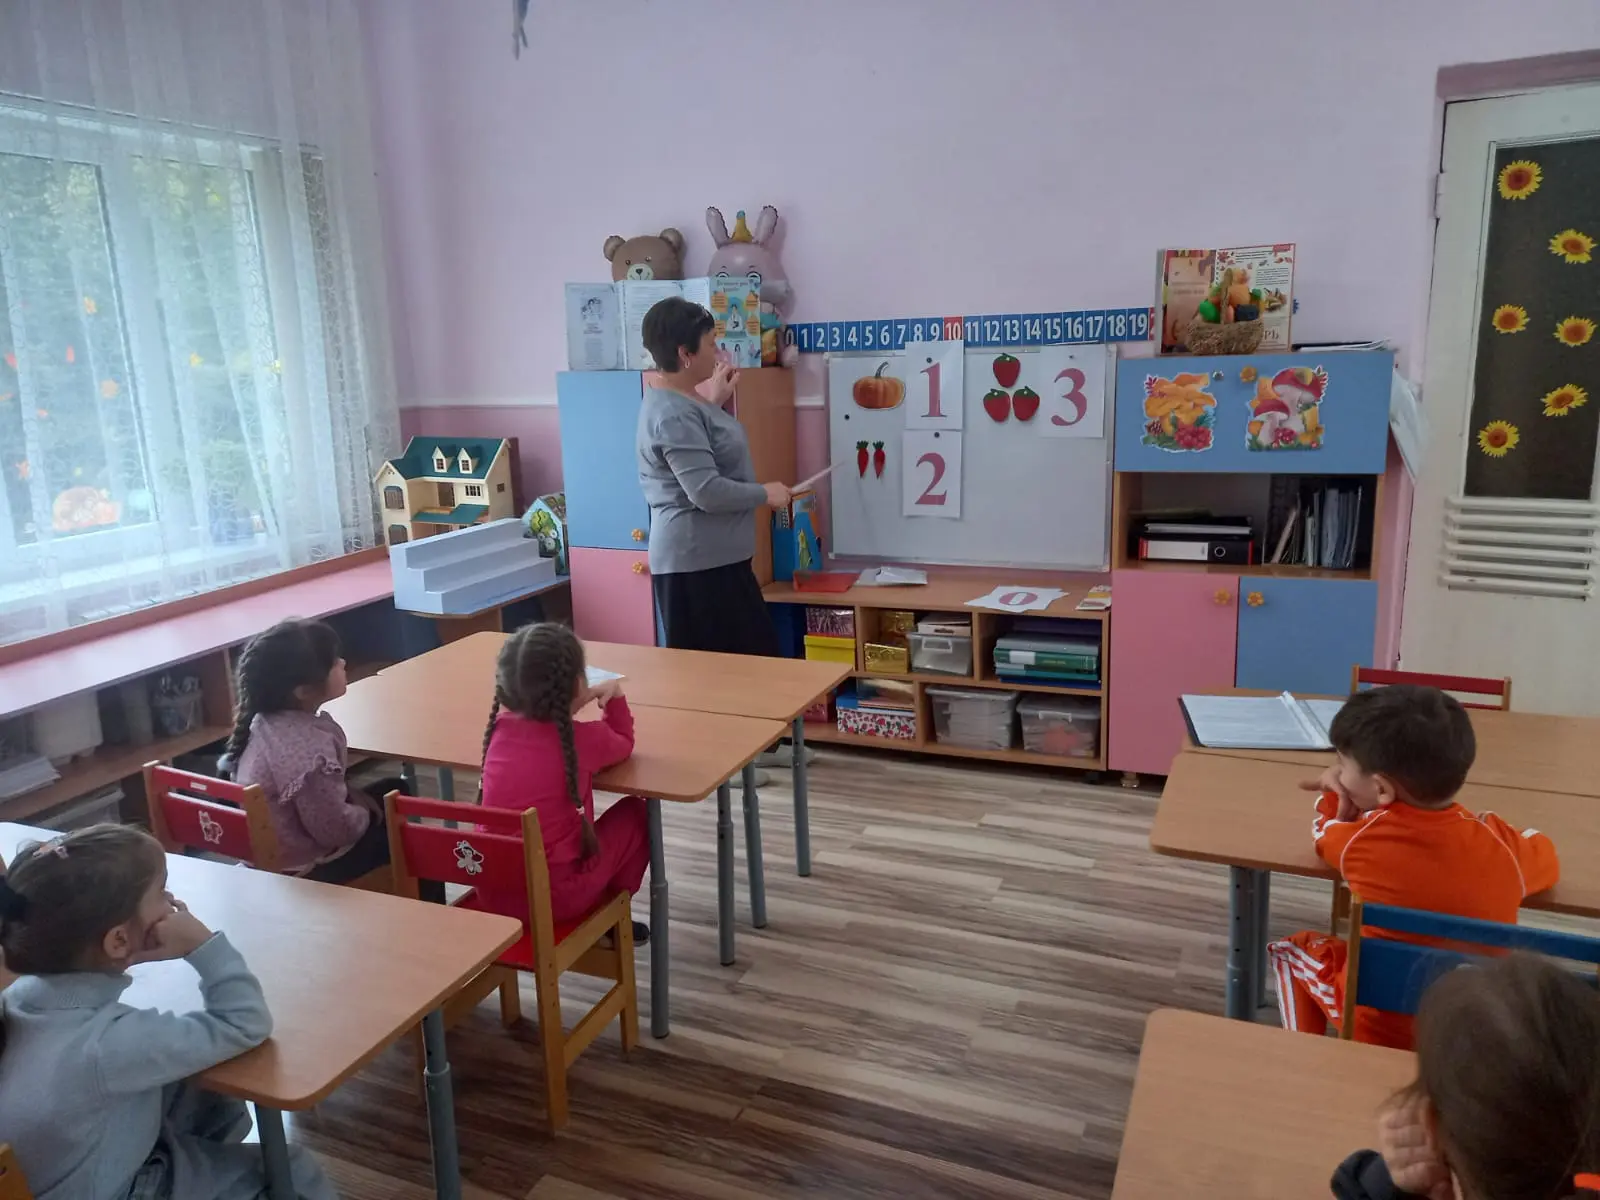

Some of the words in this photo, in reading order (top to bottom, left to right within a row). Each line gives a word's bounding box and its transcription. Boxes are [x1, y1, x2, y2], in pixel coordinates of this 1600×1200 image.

[786, 329, 795, 346] 0
[801, 328, 809, 348] 1
[816, 328, 825, 348] 2
[832, 327, 841, 347] 3
[848, 326, 858, 347] 4
[865, 325, 873, 346] 5
[880, 325, 890, 345] 6
[897, 324, 906, 345] 7
[913, 323, 923, 342] 8
[930, 323, 940, 341] 9
[945, 322, 961, 341] 10
[965, 320, 979, 342] 11
[984, 320, 1000, 342] 12
[1004, 319, 1020, 341] 13
[1023, 319, 1041, 340] 14
[1044, 318, 1061, 340] 15
[1065, 317, 1083, 338] 16
[1086, 315, 1103, 338] 17
[1107, 314, 1126, 337] 18
[1129, 313, 1148, 336] 19
[919, 362, 948, 418] 1
[1050, 367, 1088, 427] 3
[914, 452, 948, 506] 2
[998, 591, 1038, 606] 0
